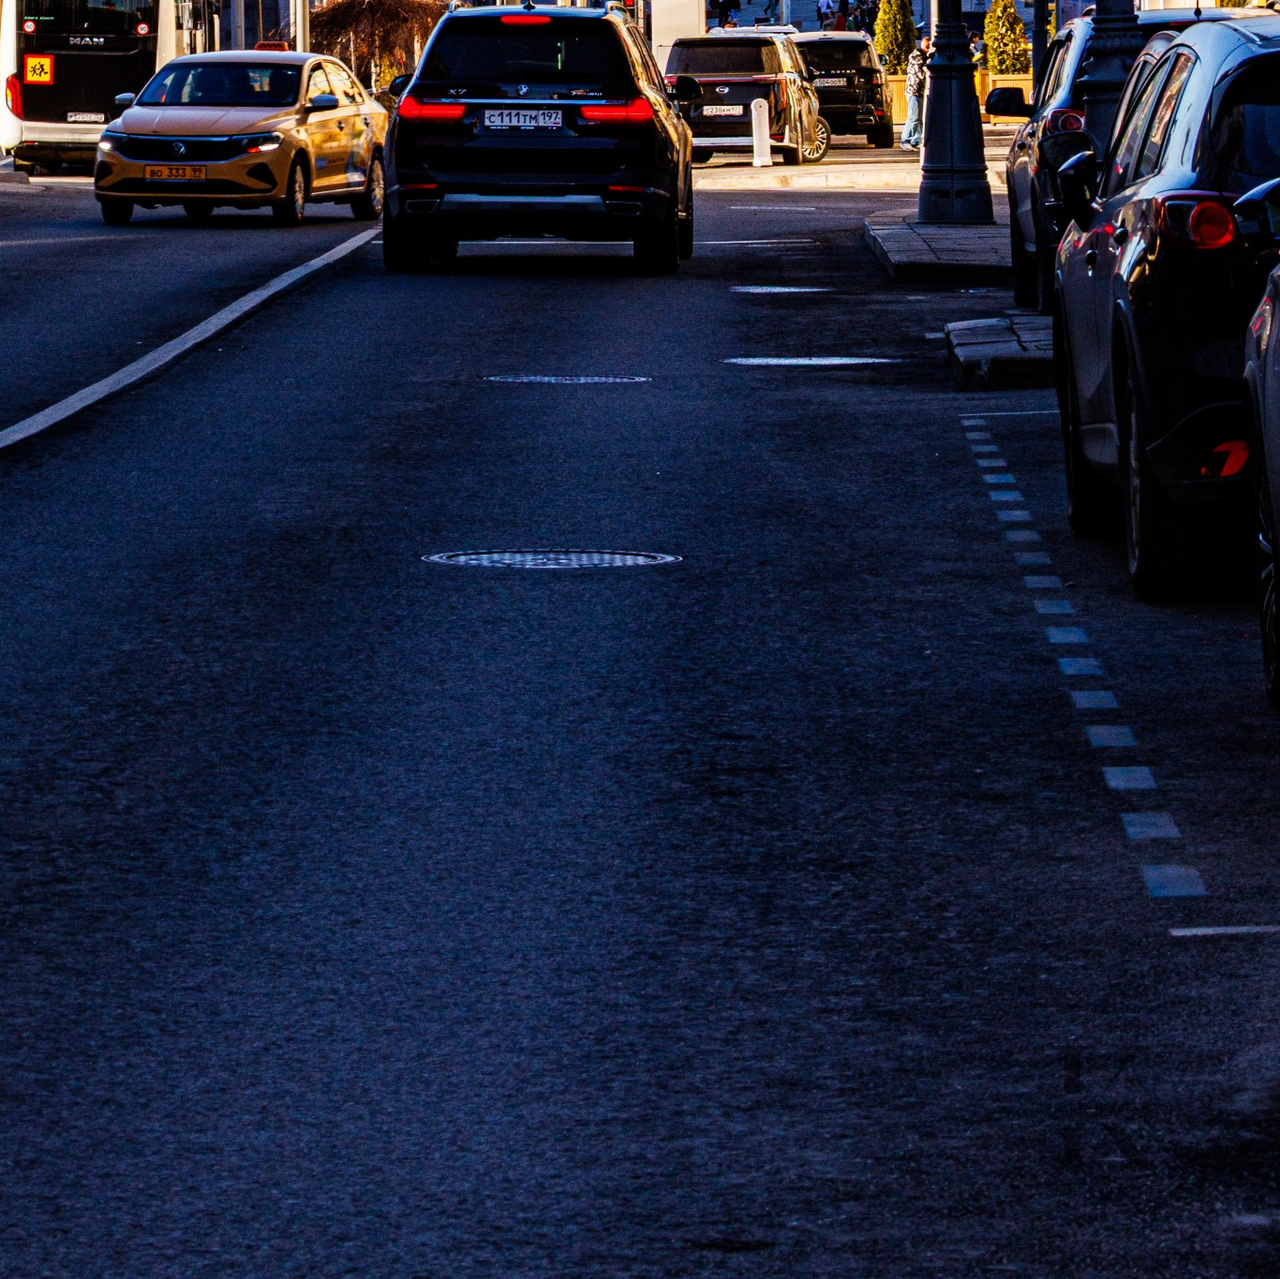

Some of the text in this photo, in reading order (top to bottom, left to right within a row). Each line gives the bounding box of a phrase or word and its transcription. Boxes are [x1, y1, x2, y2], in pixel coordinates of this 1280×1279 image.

[69, 37, 105, 45] MAN
[449, 88, 467, 96] X7
[166, 166, 187, 178] 333
[192, 167, 203, 176] 99
